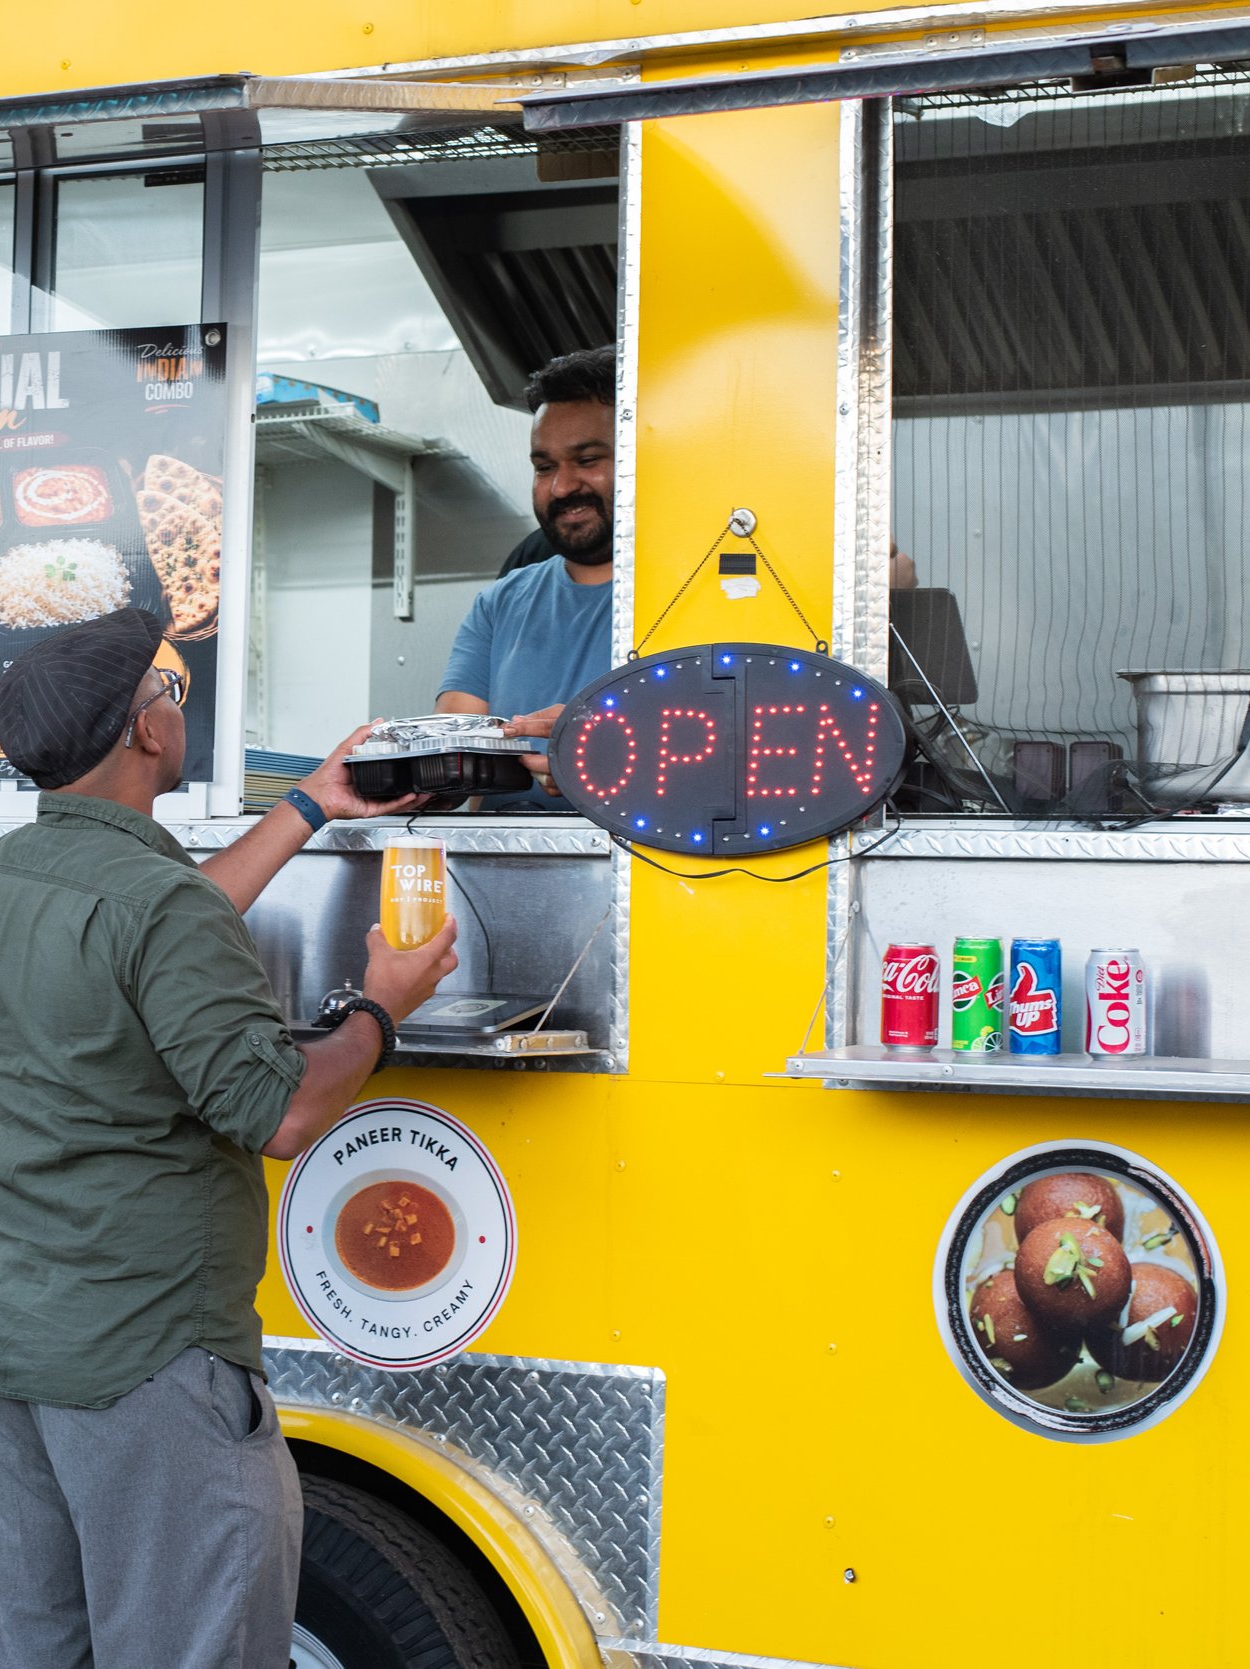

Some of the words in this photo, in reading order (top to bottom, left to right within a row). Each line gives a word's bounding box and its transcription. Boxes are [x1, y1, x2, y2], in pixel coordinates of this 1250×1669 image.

[137, 343, 204, 359] Delicious
[145, 382, 193, 400] COMBO
[4, 438, 15, 449] OF
[17, 434, 54, 448] FLAVOR!
[576, 704, 878, 797] OPEN
[390, 864, 426, 878] TOP
[399, 878, 444, 893] WIRE
[1097, 960, 1130, 1054] Coke
[1016, 1011, 1040, 1028] UP
[333, 1127, 402, 1166] PANEER
[410, 1129, 459, 1172] TIKKA
[423, 1279, 474, 1333] CREAMY
